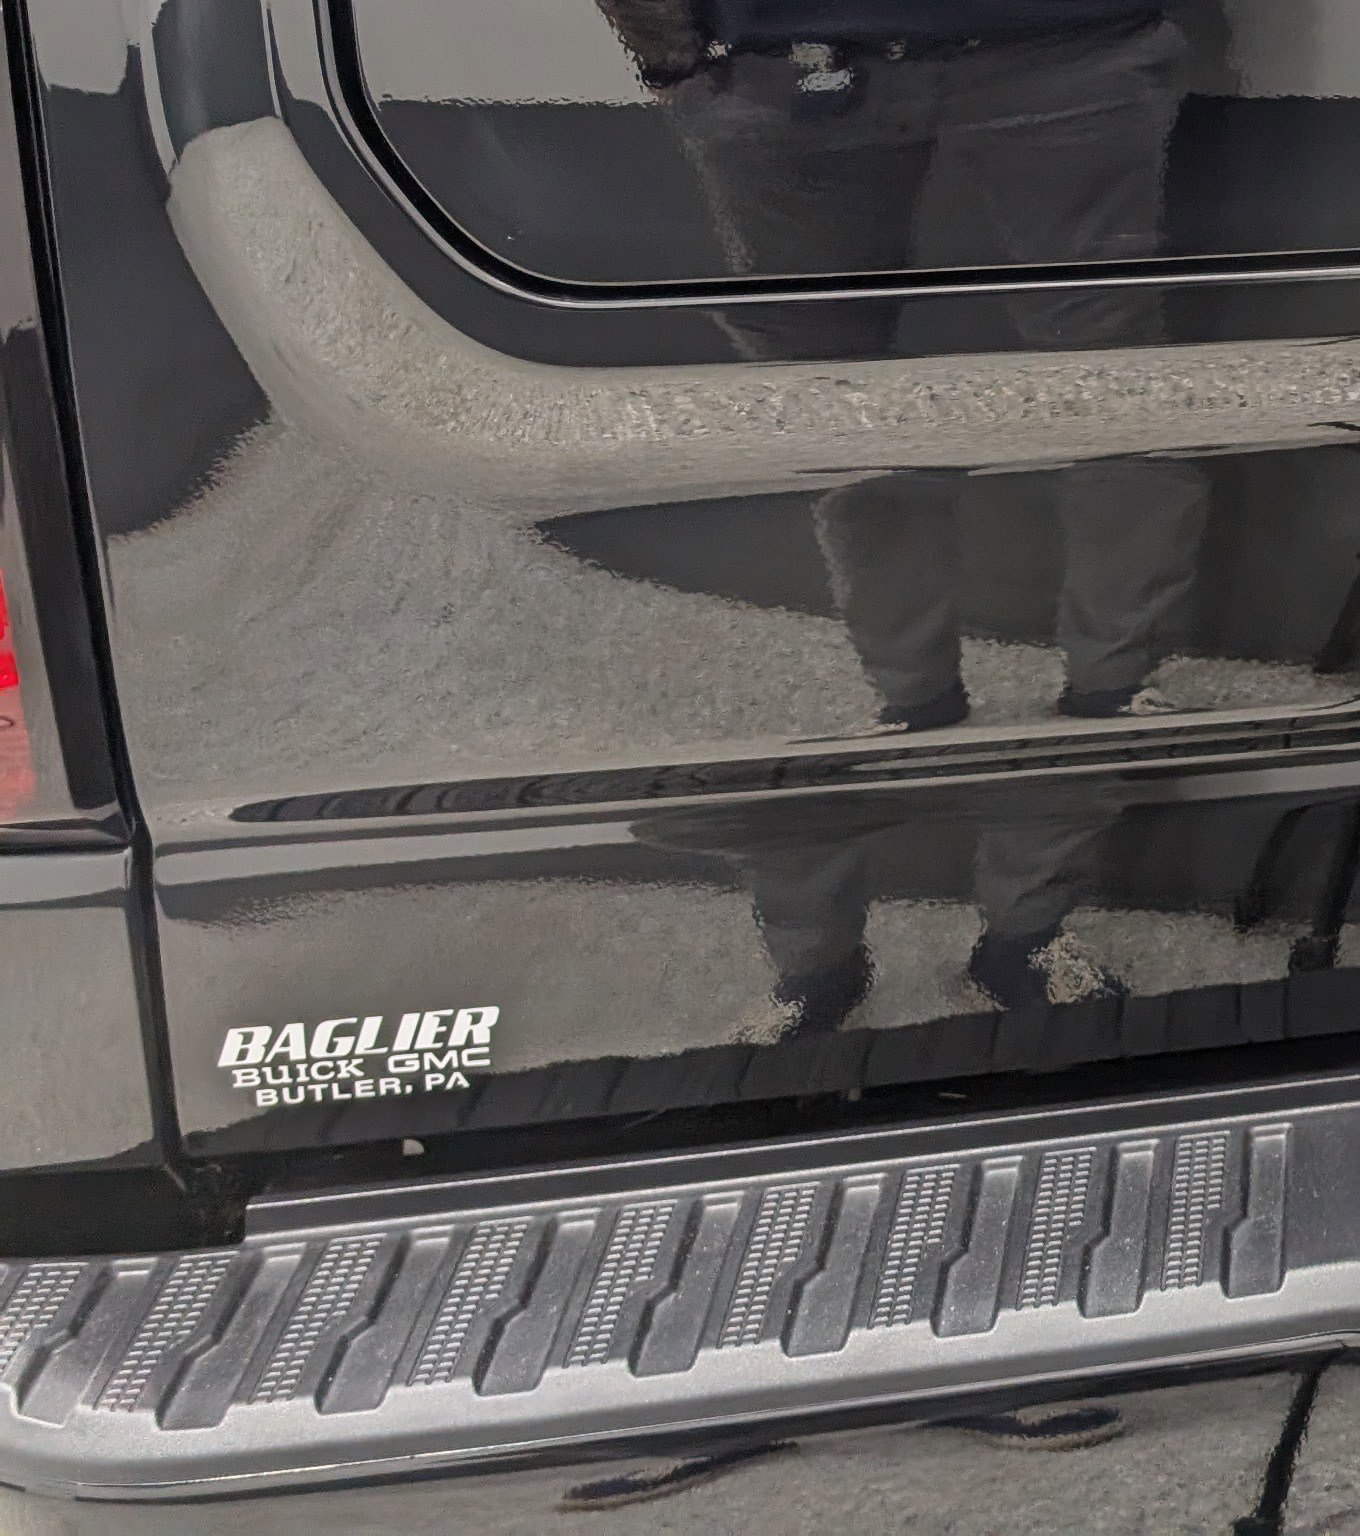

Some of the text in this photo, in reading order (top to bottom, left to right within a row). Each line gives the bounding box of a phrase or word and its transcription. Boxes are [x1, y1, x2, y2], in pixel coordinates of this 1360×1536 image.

[217, 1005, 500, 1068] BAGLIER
[232, 1046, 491, 1088] BUICK GMC
[255, 1071, 470, 1107] BUTLER, PA
